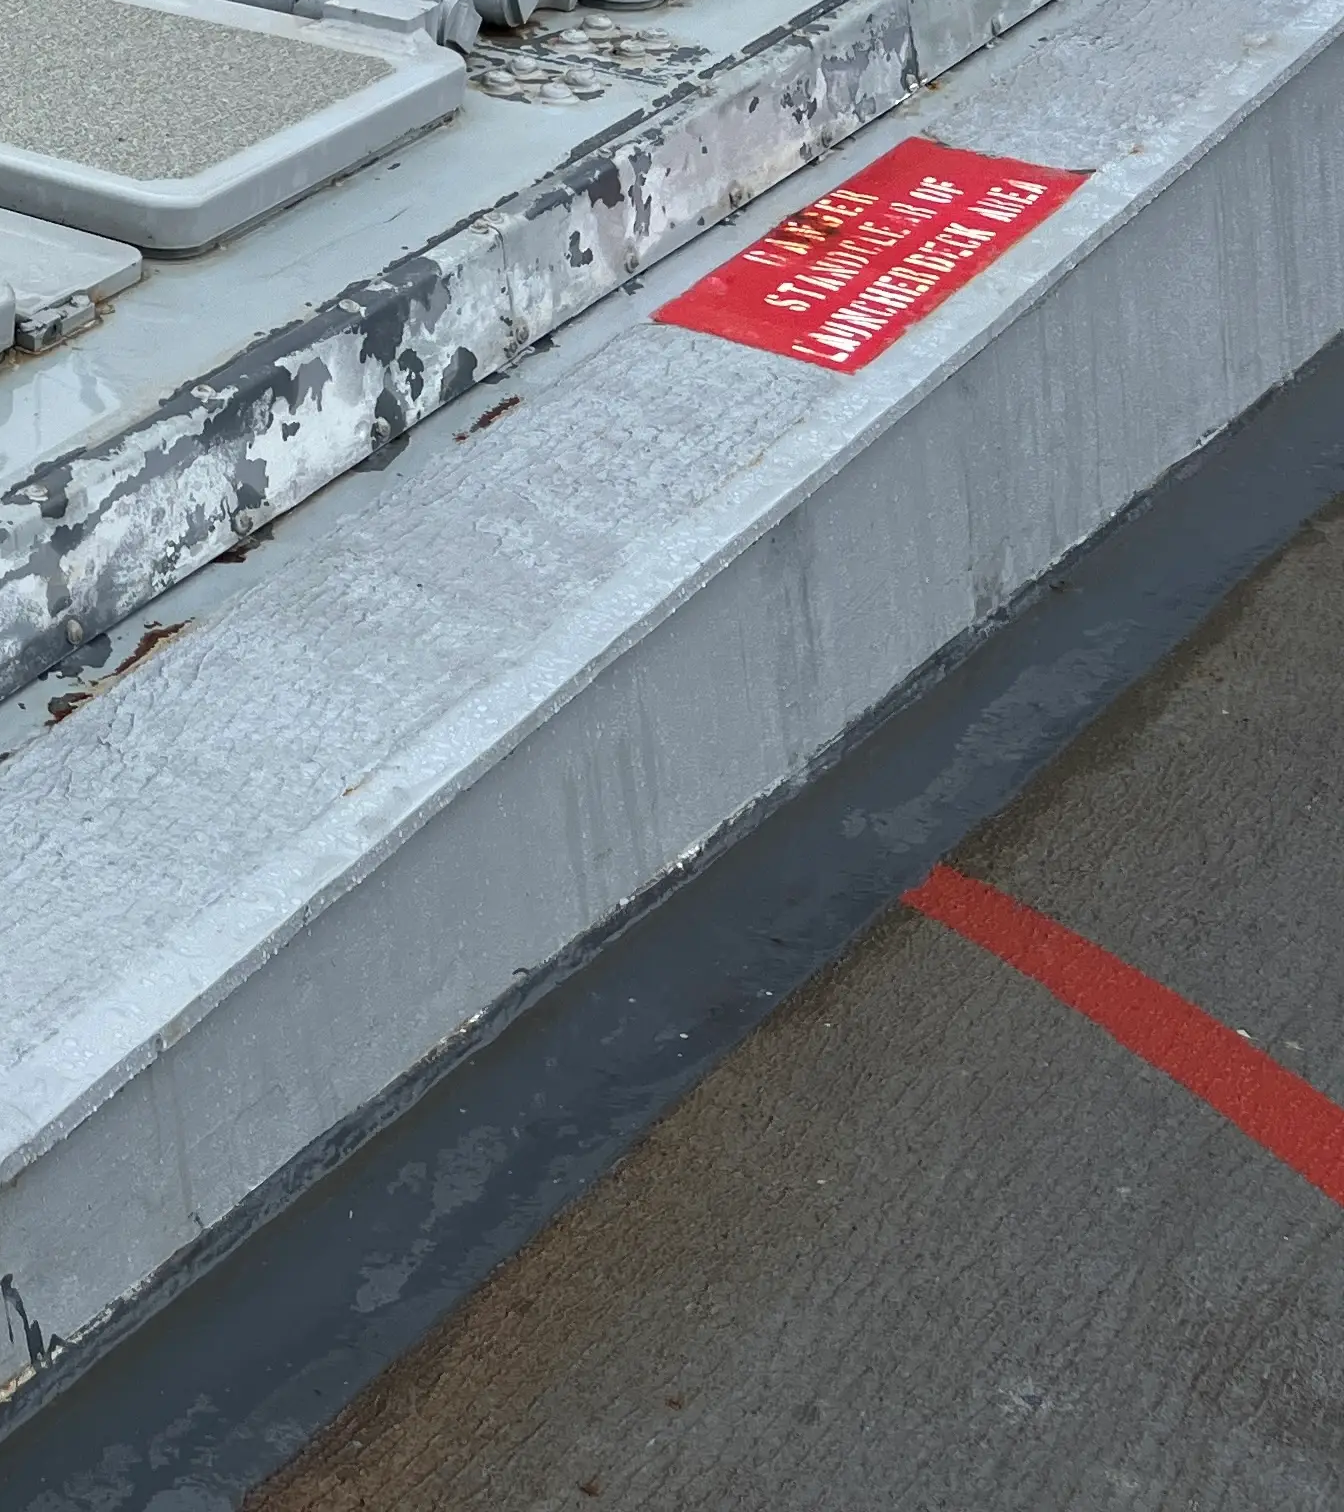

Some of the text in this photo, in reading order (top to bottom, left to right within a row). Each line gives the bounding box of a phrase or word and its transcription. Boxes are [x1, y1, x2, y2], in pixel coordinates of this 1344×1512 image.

[909, 176, 964, 204] OF
[967, 178, 1048, 223] AREA
[742, 189, 880, 267] DANGER
